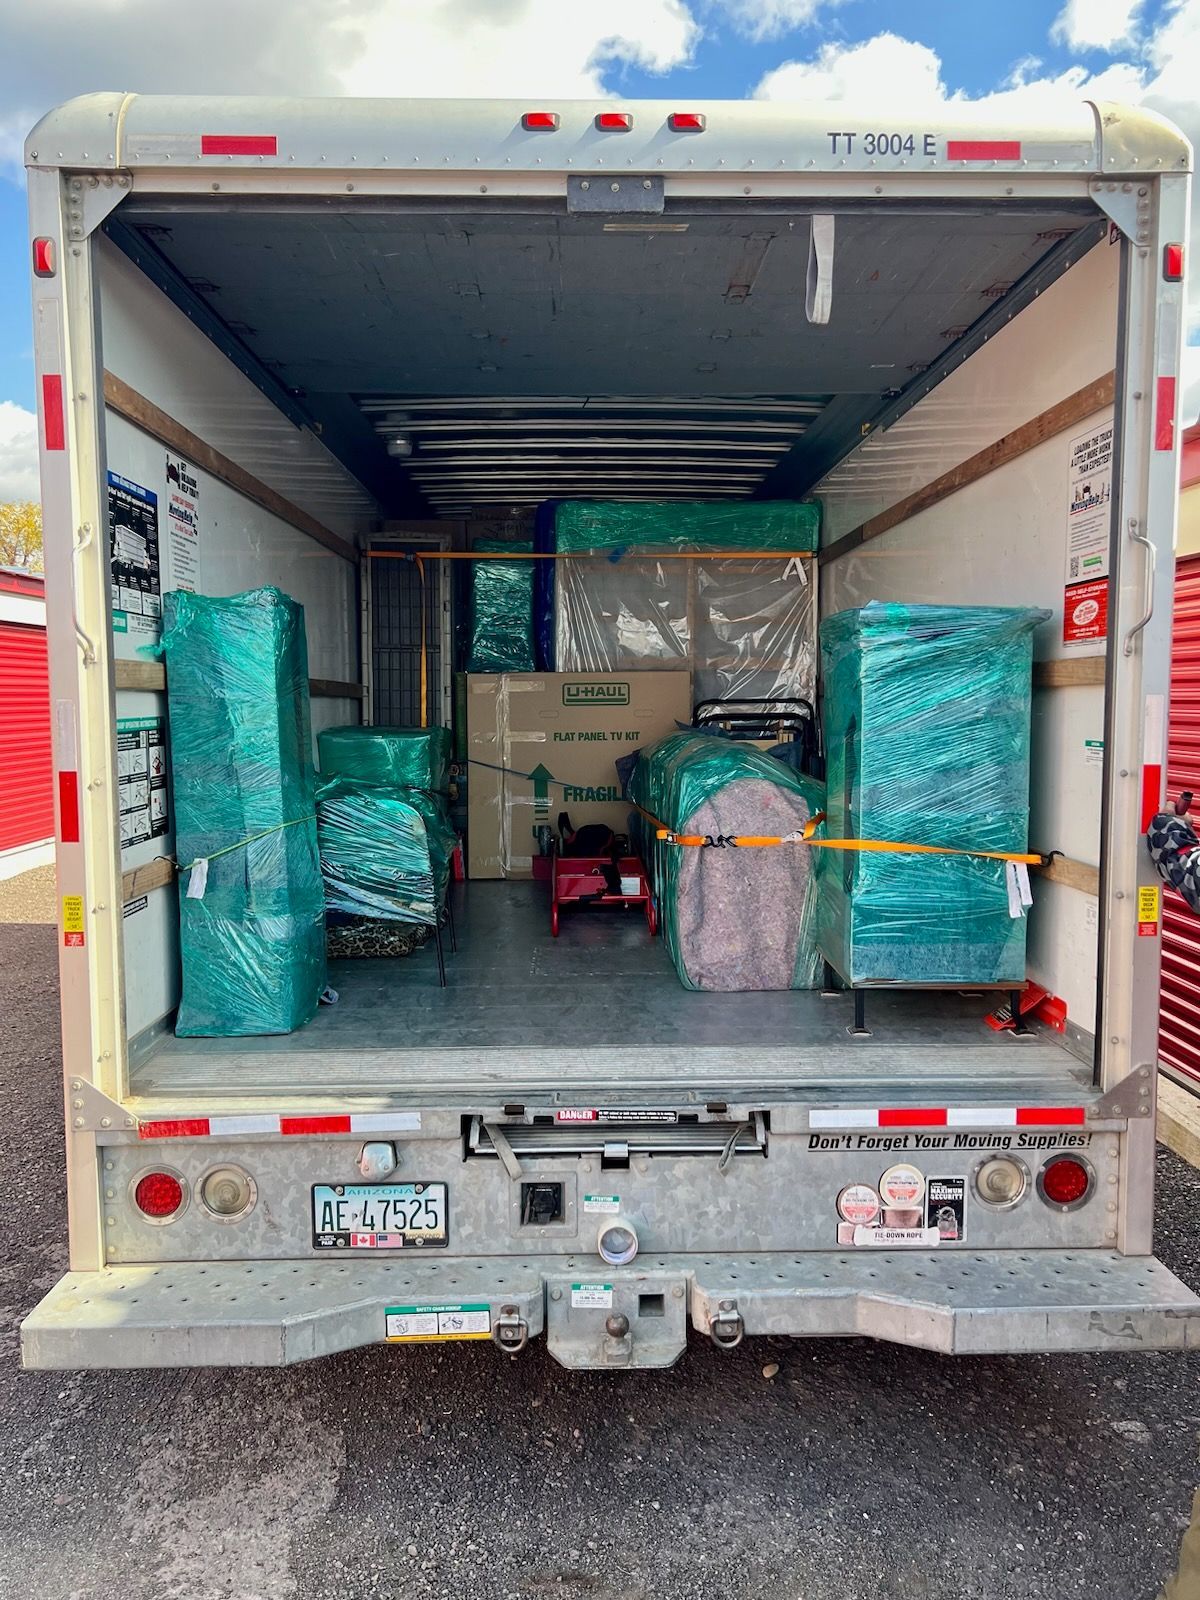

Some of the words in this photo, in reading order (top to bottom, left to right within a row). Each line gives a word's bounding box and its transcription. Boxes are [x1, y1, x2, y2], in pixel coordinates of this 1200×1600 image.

[827, 132, 856, 155] TT
[863, 133, 915, 156] 3004
[923, 134, 937, 156] E
[566, 686, 626, 697] U-HAUL
[553, 732, 576, 742] FLAT
[578, 732, 608, 742] PANEL
[610, 732, 623, 741] TV
[625, 731, 640, 741] KIT
[563, 786, 622, 802] FRAGIL
[560, 1111, 593, 1119] DANGER
[808, 1133, 852, 1148] Don't
[857, 1134, 909, 1151] Forget
[914, 1134, 949, 1148] Your
[954, 1133, 1012, 1150] Moving
[1017, 1132, 1093, 1150] Supplies!
[347, 1188, 413, 1196] ARIZONA
[321, 1200, 350, 1231] AE
[362, 1199, 438, 1231] 47525
